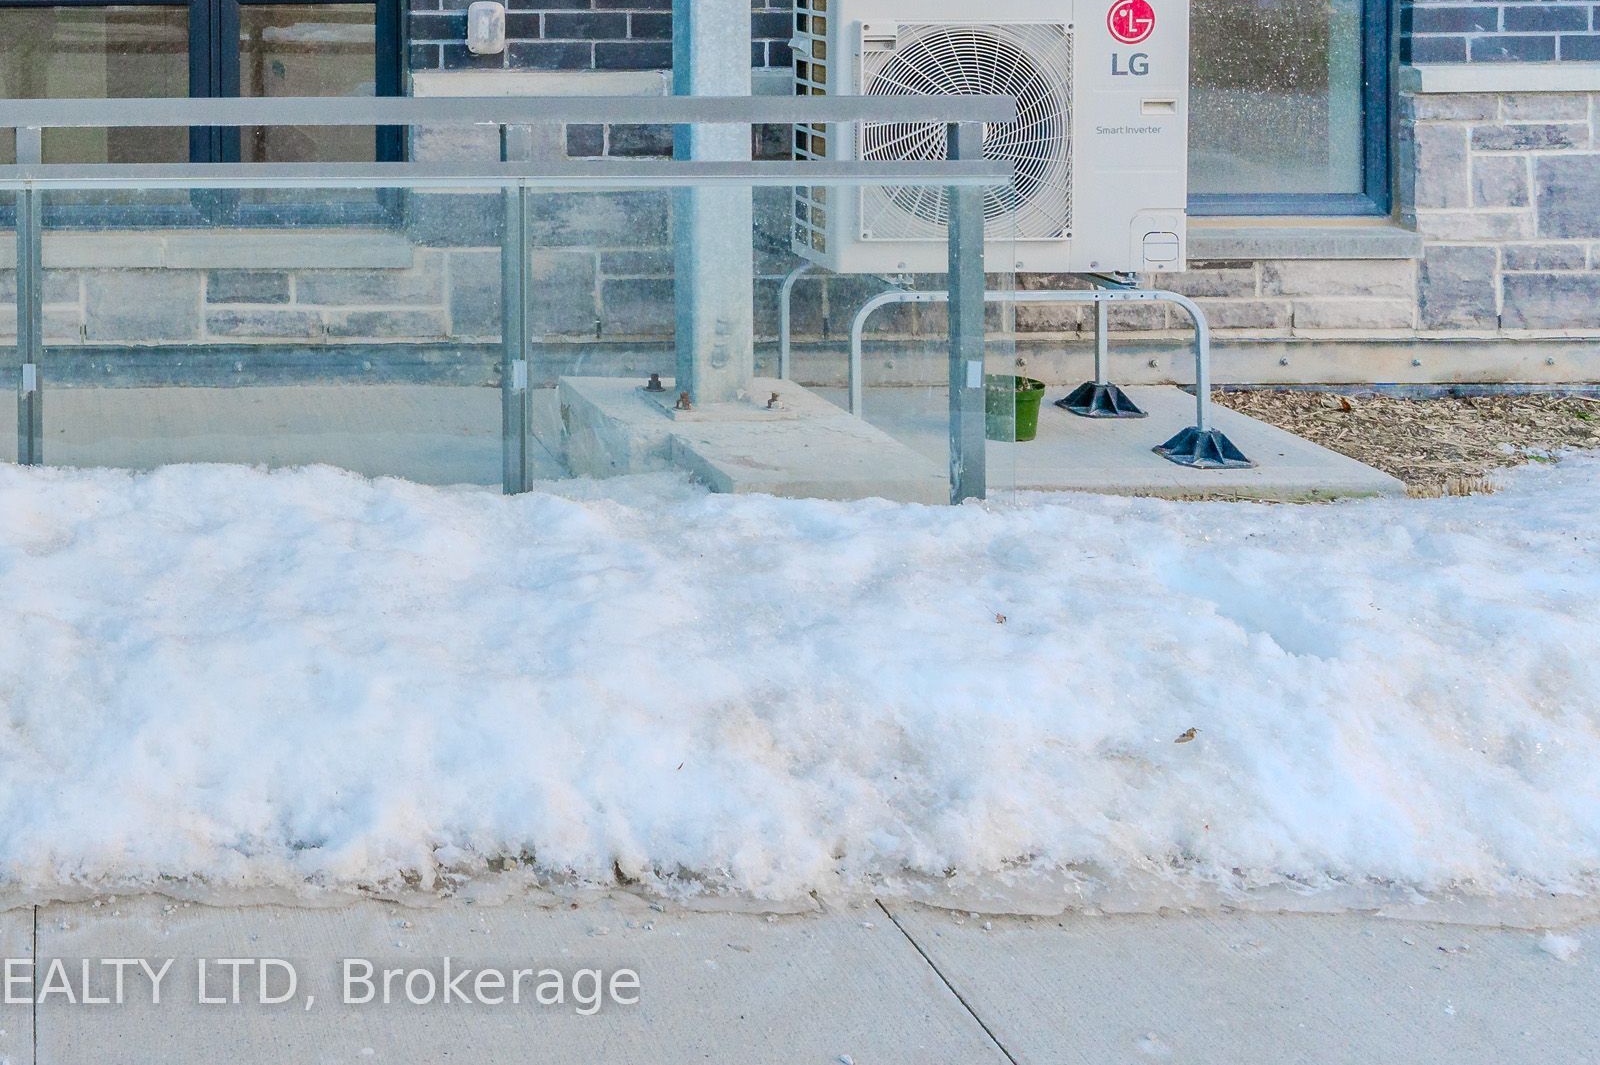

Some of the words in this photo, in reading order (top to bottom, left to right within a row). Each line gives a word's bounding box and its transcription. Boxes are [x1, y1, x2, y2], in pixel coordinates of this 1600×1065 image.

[1111, 52, 1149, 76] LG
[1096, 124, 1124, 135] Smart
[1125, 124, 1162, 135] Inverter
